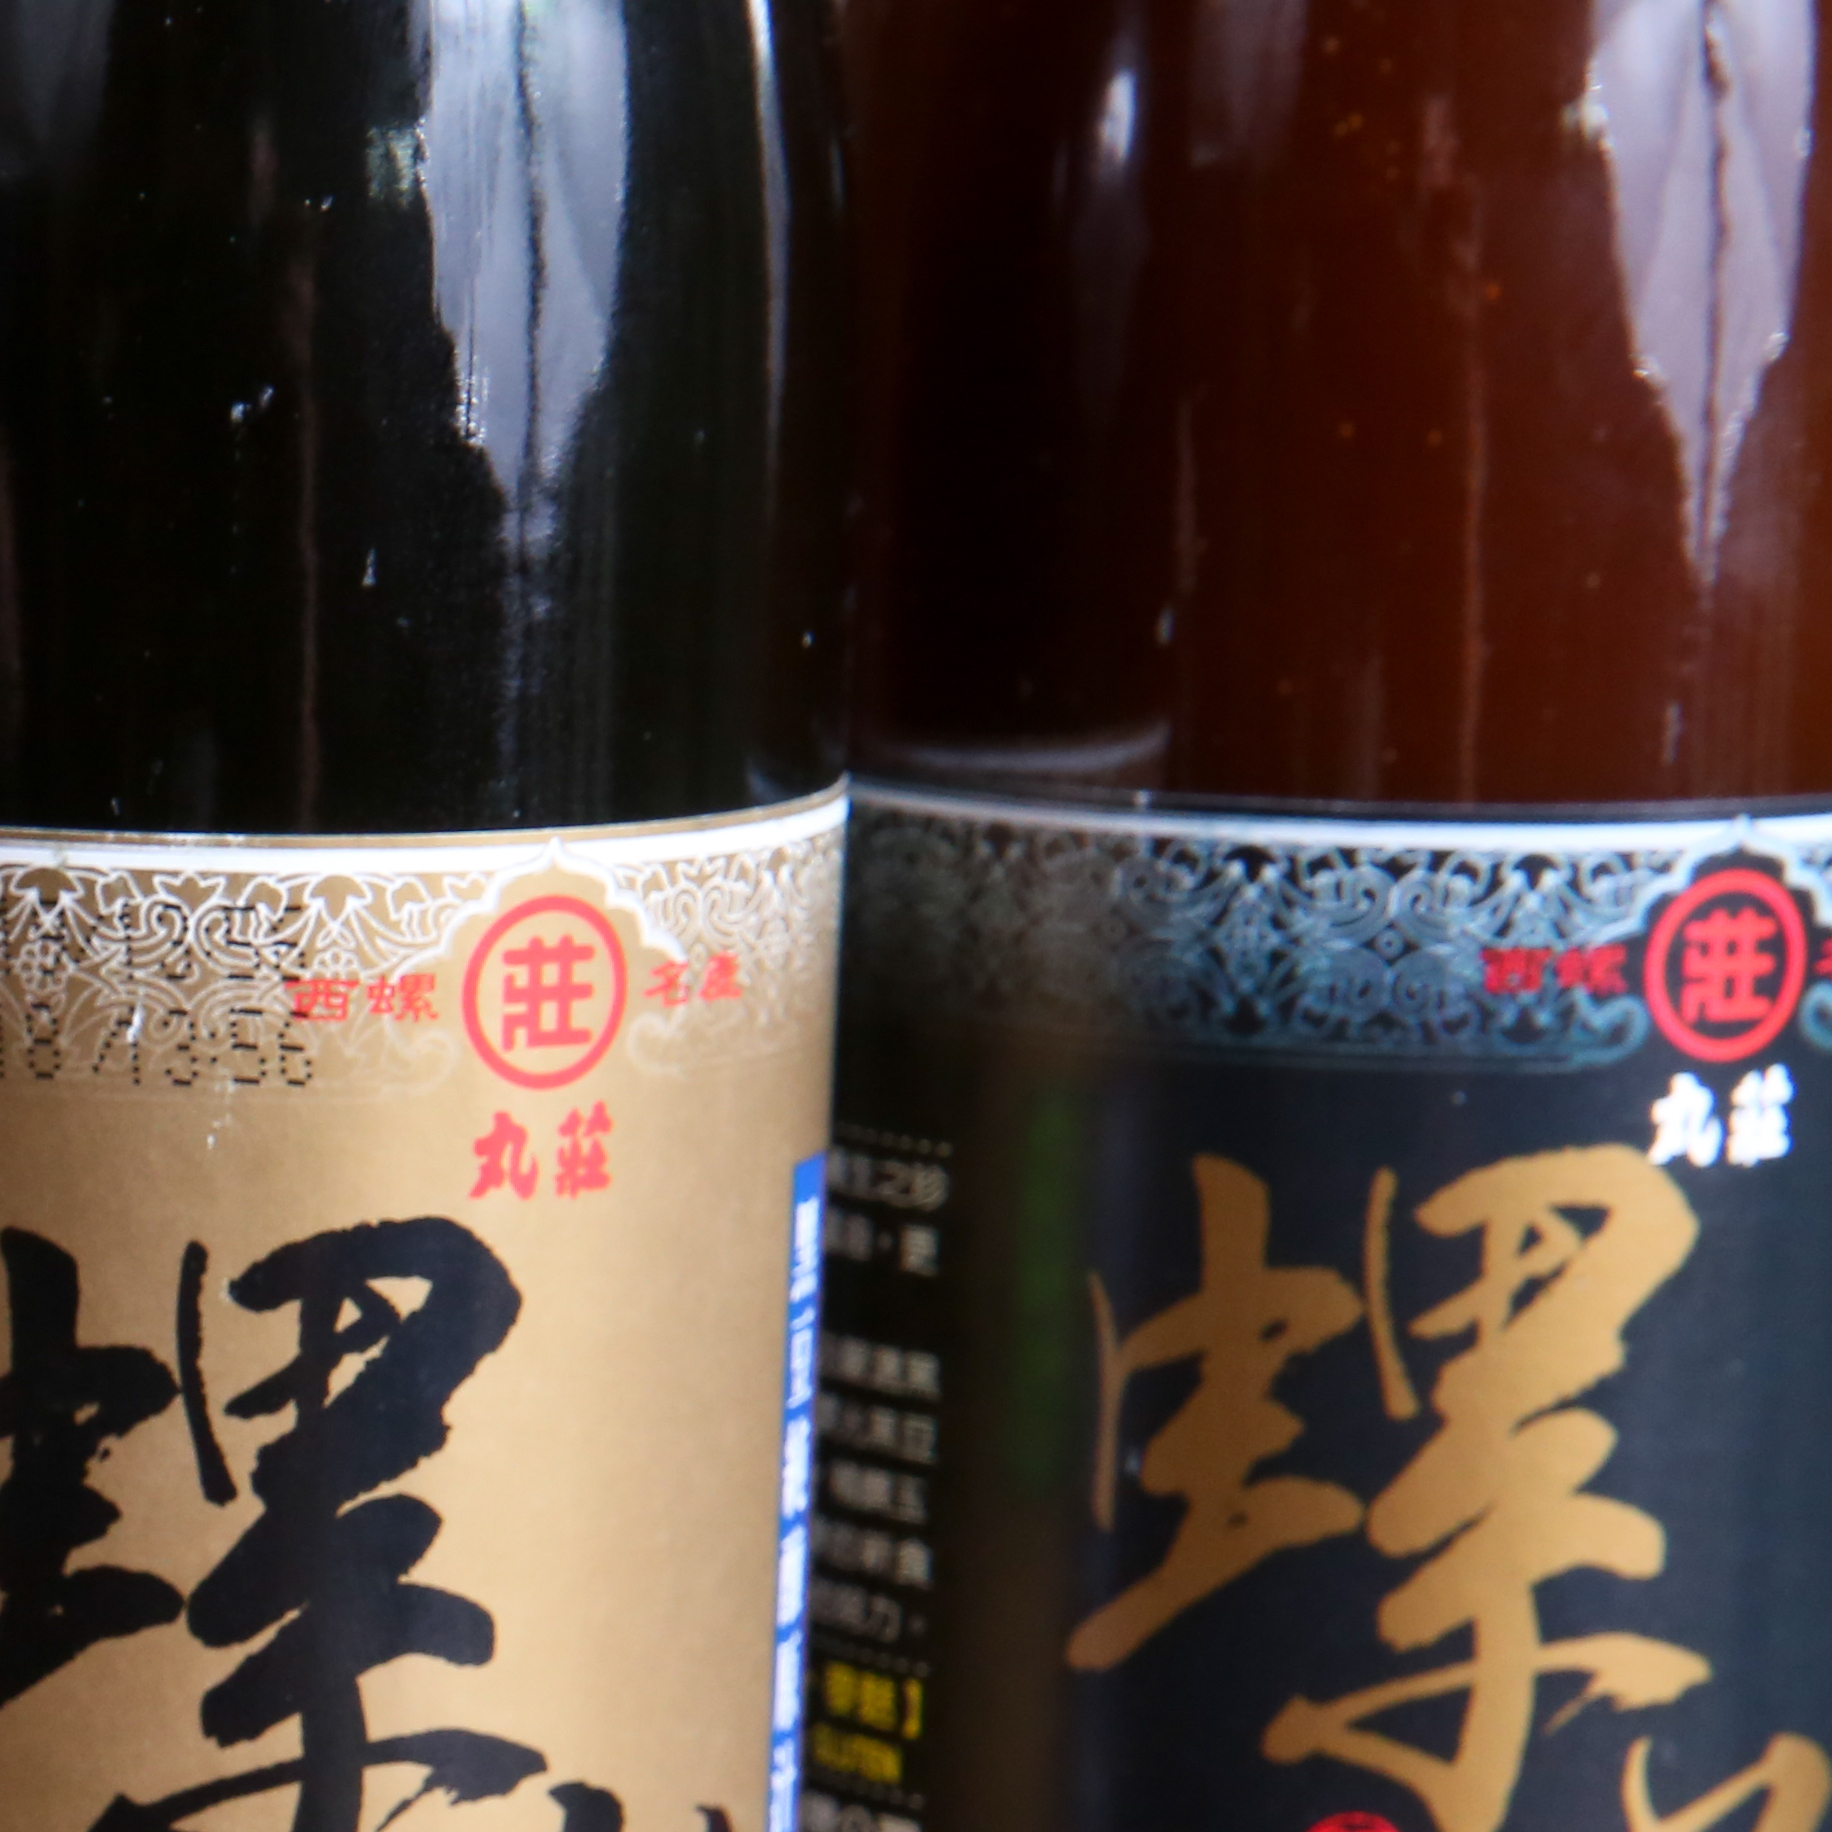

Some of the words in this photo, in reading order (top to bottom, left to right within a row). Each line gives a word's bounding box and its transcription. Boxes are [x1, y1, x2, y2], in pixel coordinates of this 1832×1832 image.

[284, 973, 439, 1023] 西螺
[468, 1101, 614, 1201] 丸莊
[1649, 1063, 1796, 1168] 丸莊
